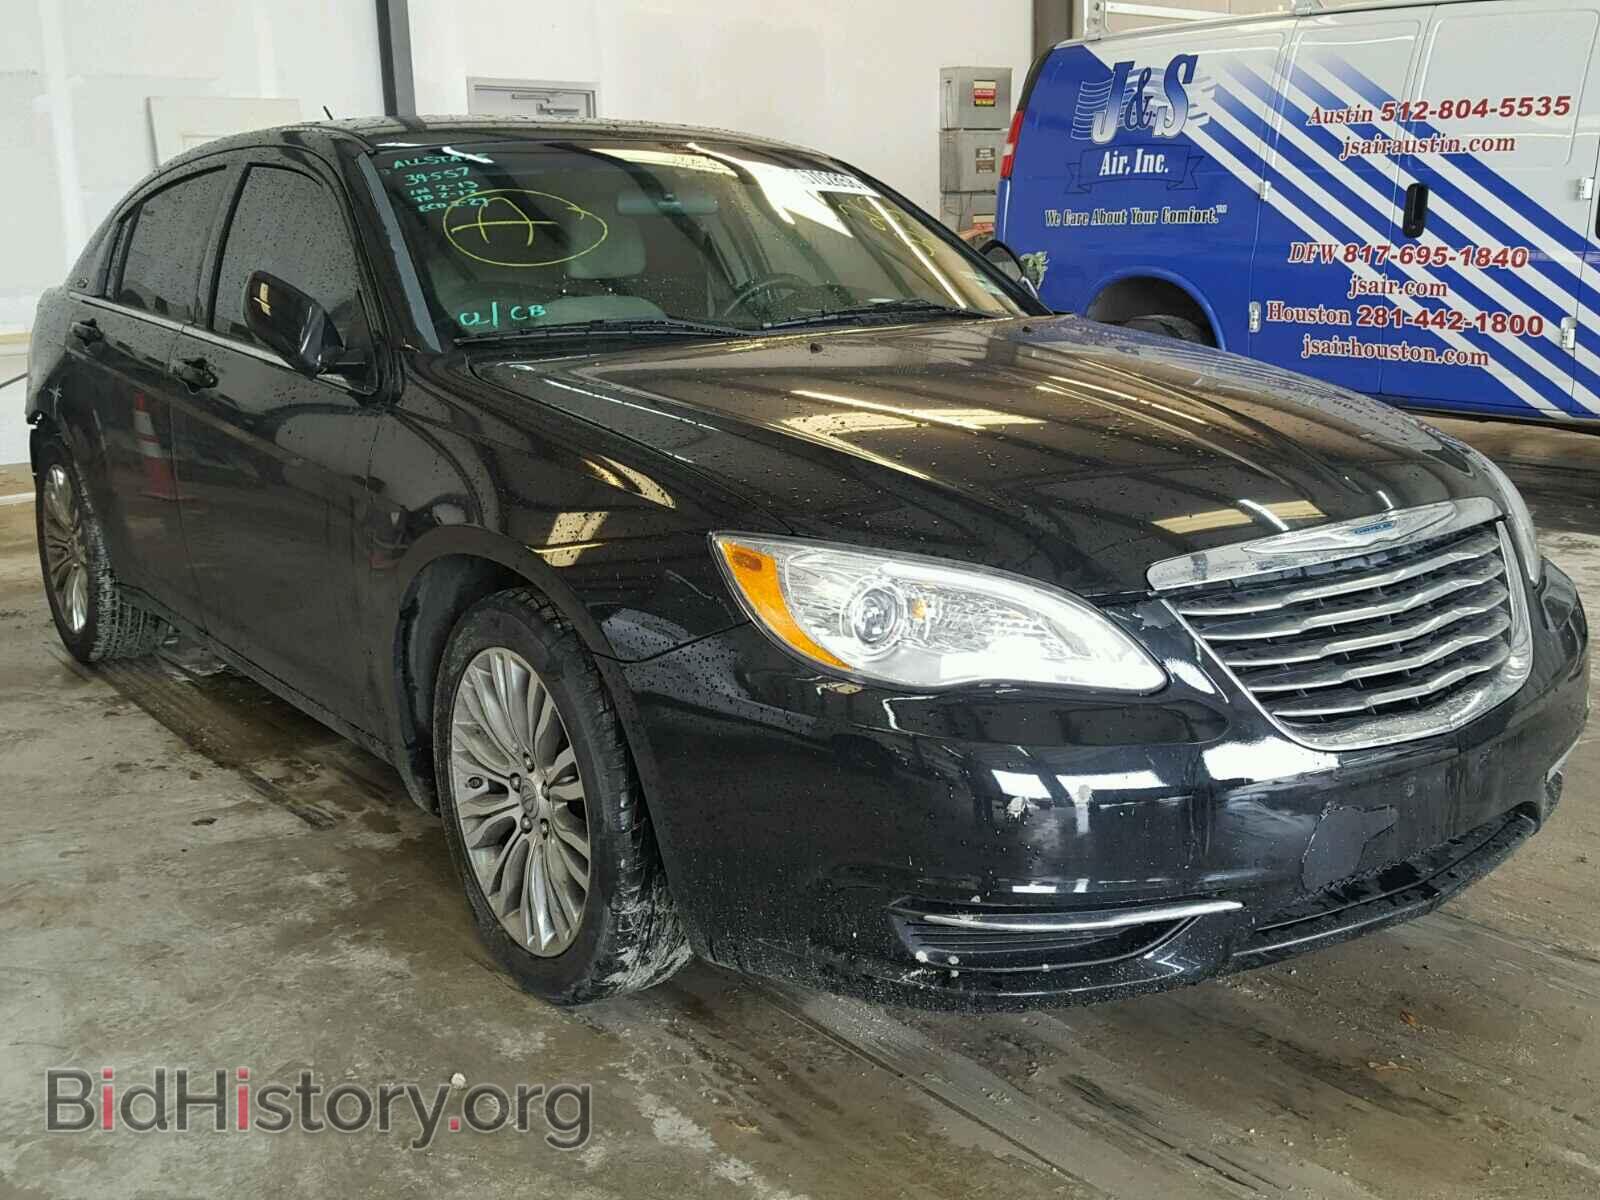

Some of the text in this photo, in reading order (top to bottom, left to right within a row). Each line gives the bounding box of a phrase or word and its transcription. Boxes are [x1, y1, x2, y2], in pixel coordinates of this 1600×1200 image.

[1091, 54, 1198, 144] J&S
[1307, 95, 1571, 125] Austin 512-804-5535
[1340, 134, 1516, 160] jsairaustin.com
[1099, 149, 1169, 176] Air, Inc.
[1045, 209, 1060, 227] We
[1063, 209, 1089, 226] Care
[1091, 208, 1127, 226] About
[1130, 207, 1159, 224] Your
[1289, 243, 1528, 268] DFW 817-695-1840
[1348, 275, 1447, 298] jsair.com
[1267, 301, 1544, 336] Houston 281-442-1800
[1302, 334, 1489, 366] jsairhouston.com
